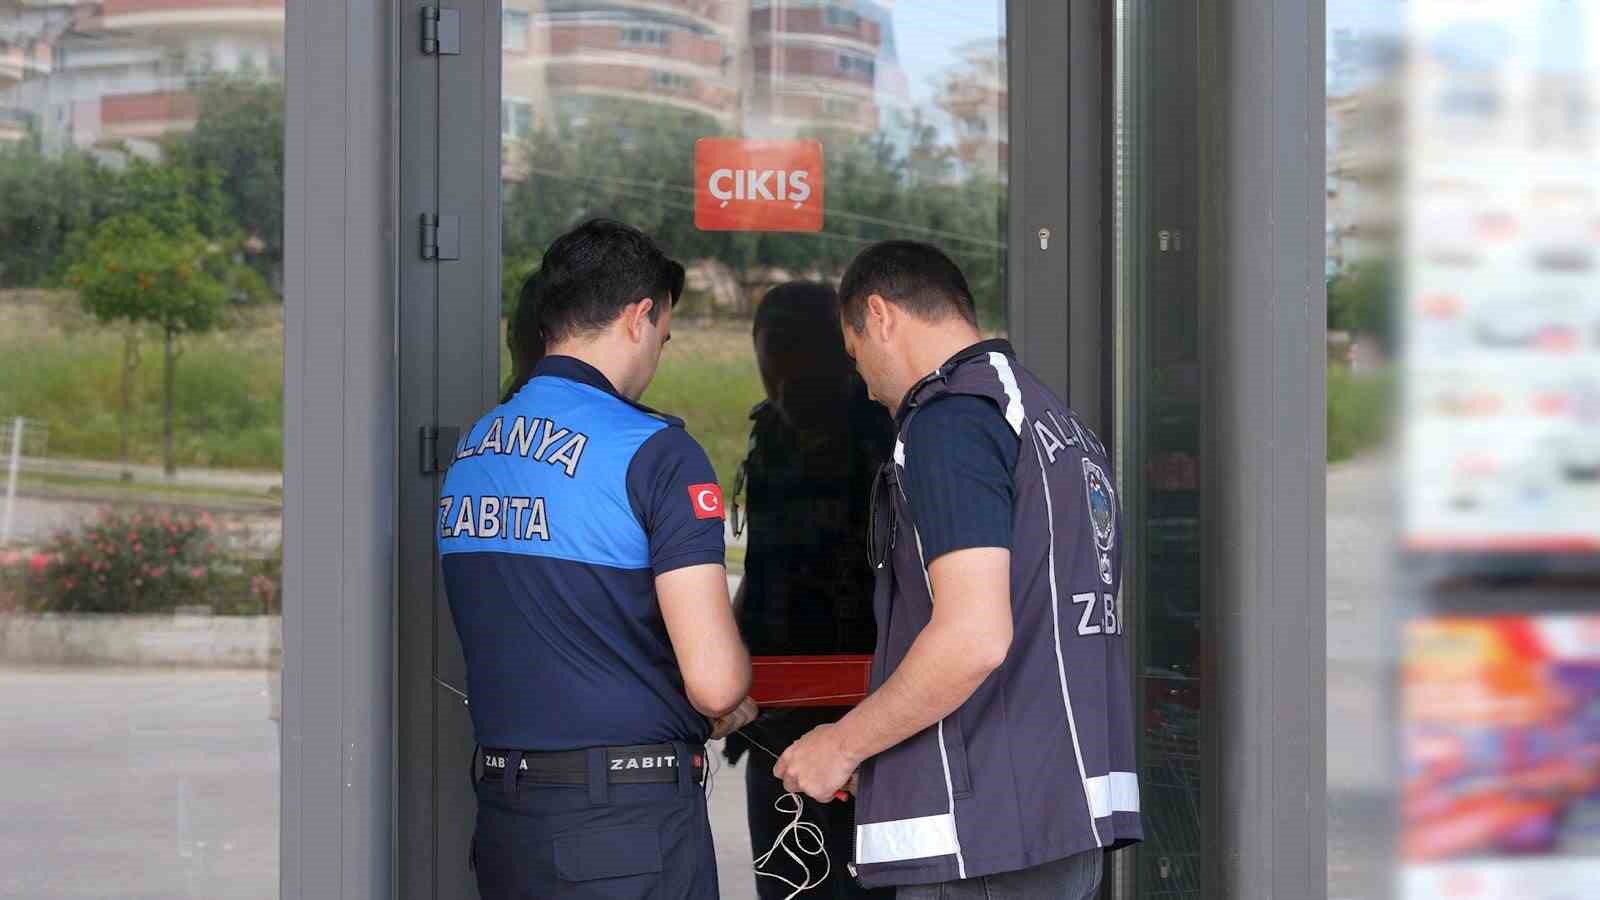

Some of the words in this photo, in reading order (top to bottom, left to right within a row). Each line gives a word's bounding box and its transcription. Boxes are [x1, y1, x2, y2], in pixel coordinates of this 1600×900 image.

[709, 168, 811, 209] ÇIKIŞ
[452, 416, 588, 477] LANYA
[485, 755, 528, 770] ZABA
[610, 755, 680, 770] ZABIT
